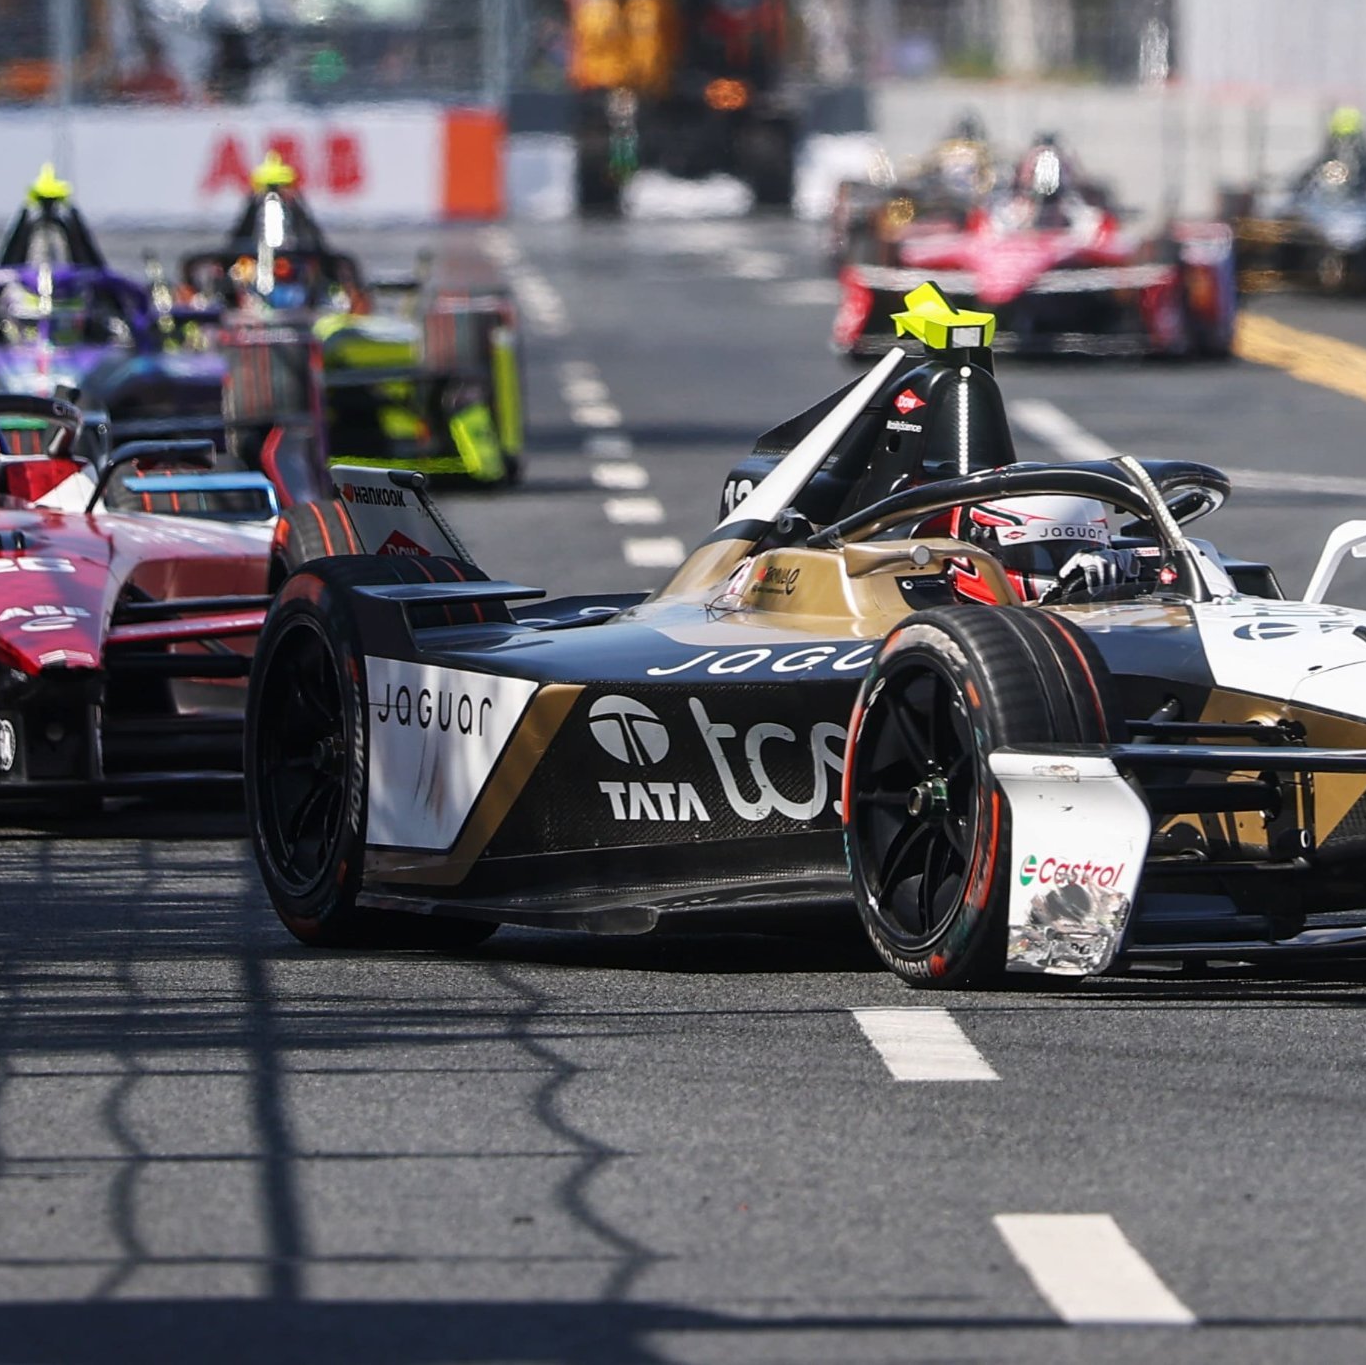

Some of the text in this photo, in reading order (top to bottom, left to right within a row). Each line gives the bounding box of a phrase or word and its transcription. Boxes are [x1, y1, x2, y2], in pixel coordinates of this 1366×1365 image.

[646, 644, 875, 676] JaGU
[598, 781, 711, 822] TATA
[1038, 857, 1125, 887] Castrol
